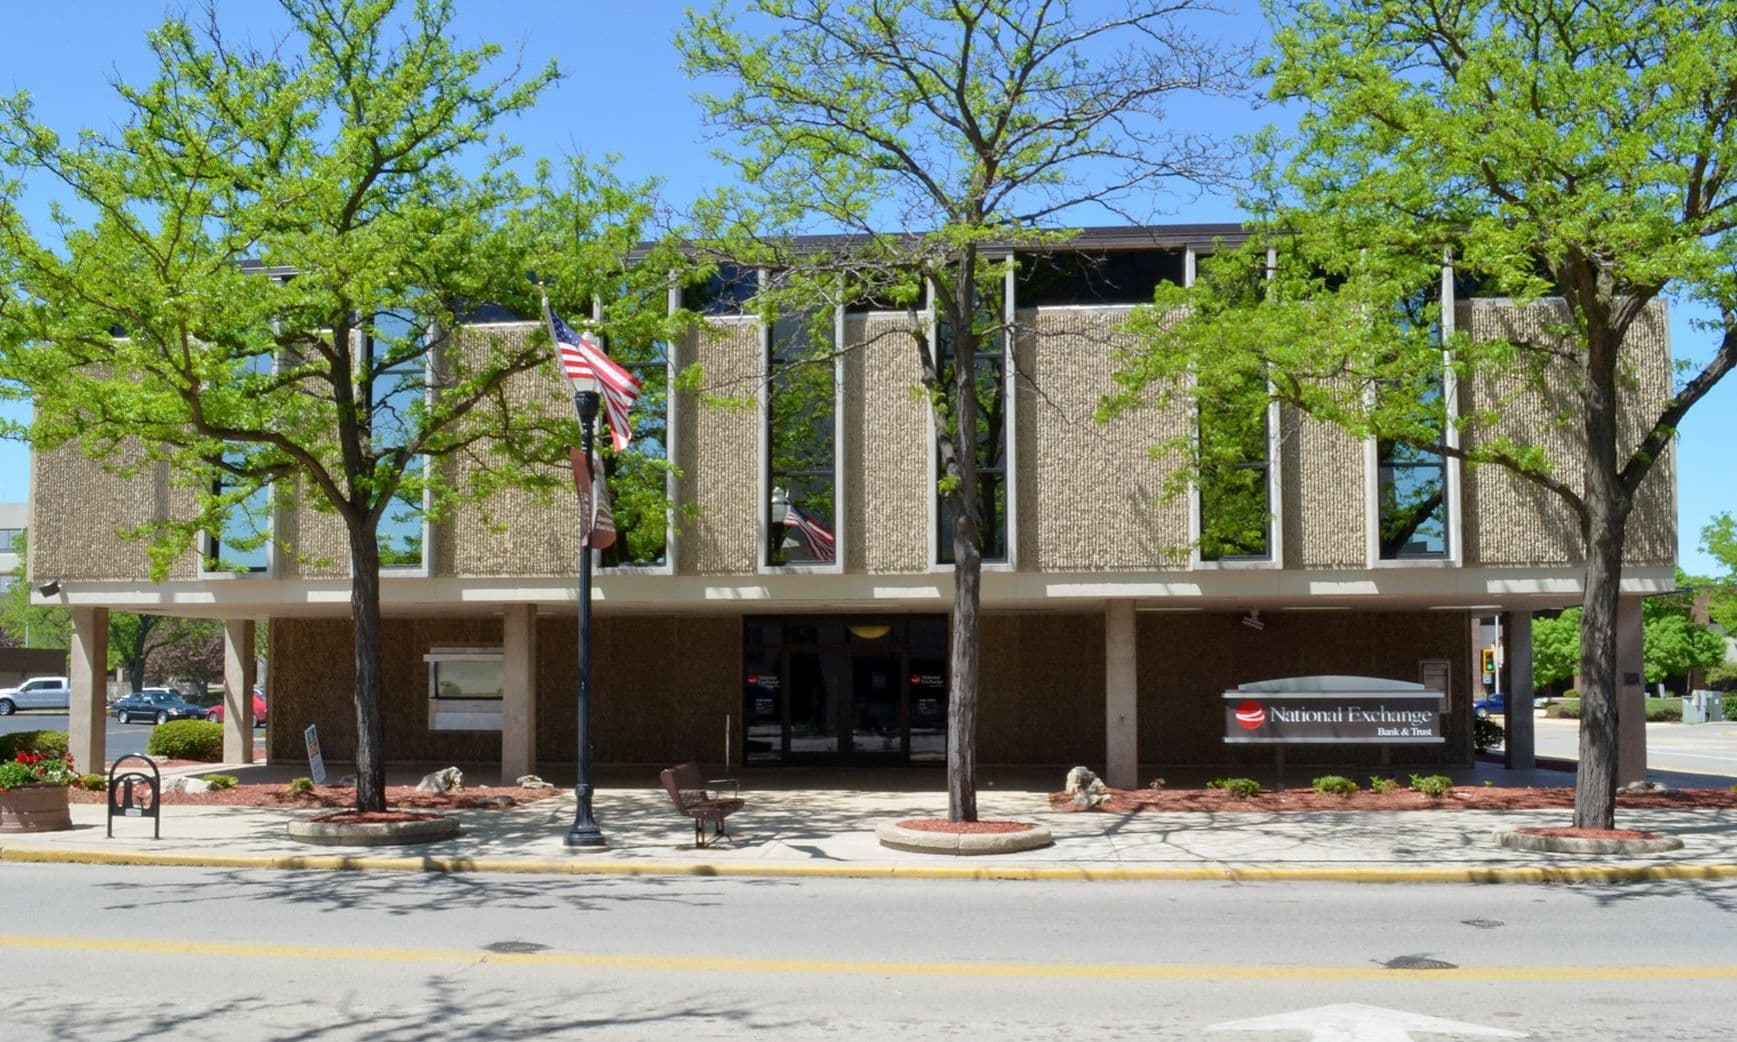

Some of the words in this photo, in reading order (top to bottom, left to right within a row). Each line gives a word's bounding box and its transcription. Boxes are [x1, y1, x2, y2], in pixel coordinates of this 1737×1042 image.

[1270, 706, 1343, 723] National
[1347, 705, 1433, 727] Exchange
[1377, 727, 1400, 736] Bank
[1400, 727, 1410, 736] &
[1410, 727, 1433, 736] Trust
